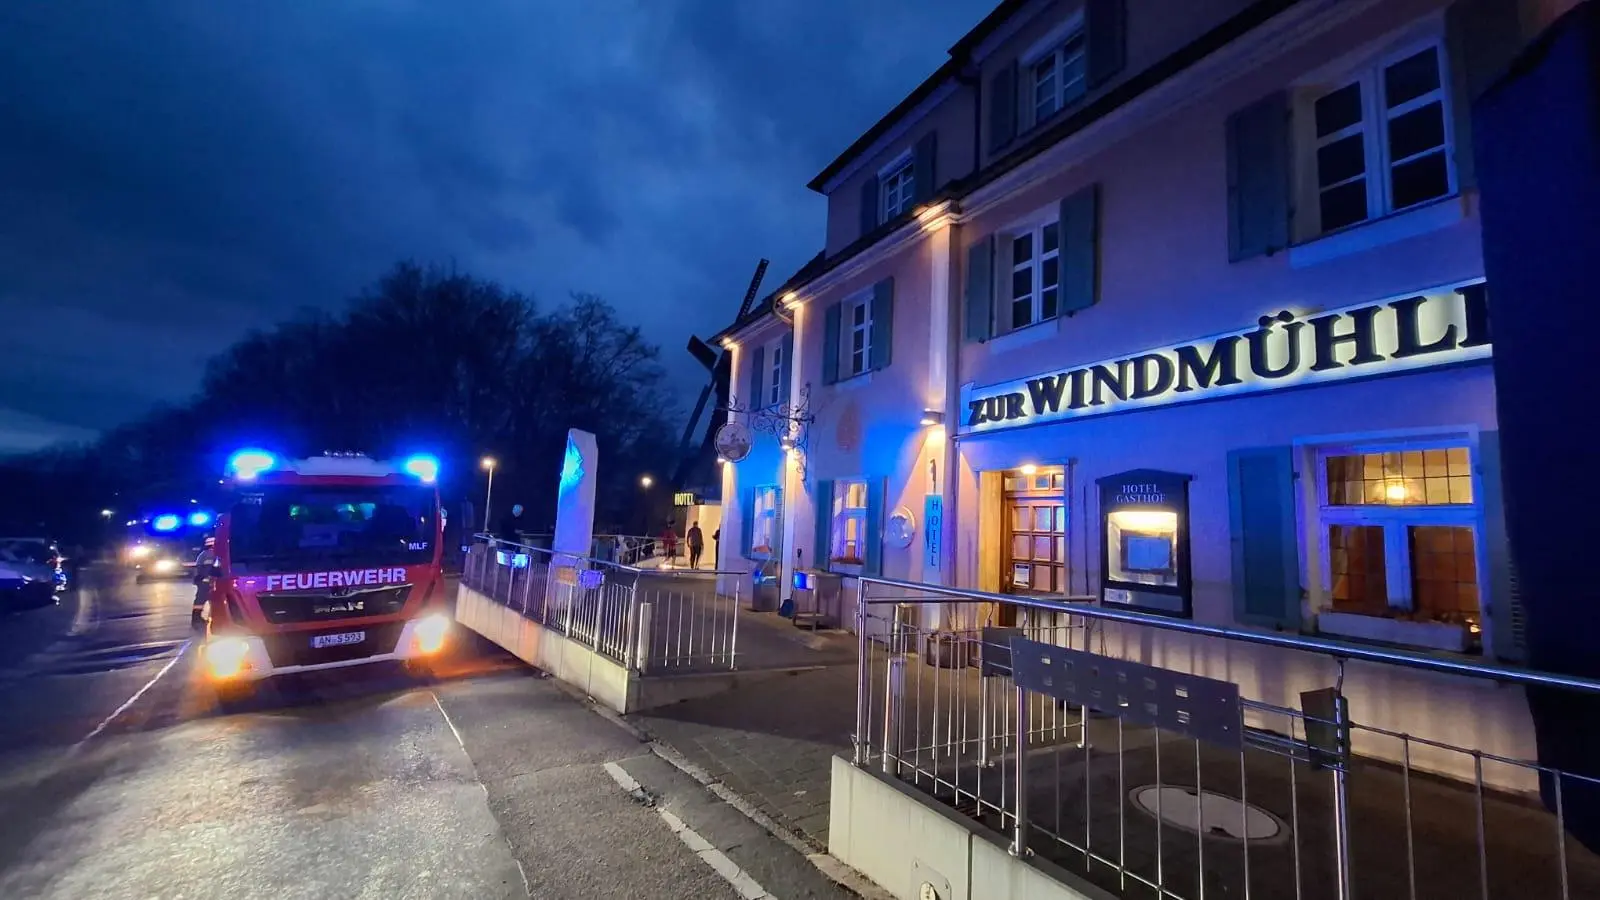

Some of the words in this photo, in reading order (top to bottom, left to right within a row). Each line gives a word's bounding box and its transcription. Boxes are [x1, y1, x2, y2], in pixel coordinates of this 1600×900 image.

[968, 392, 1027, 426] ZUR
[1122, 484, 1160, 494] HOTEL
[674, 492, 694, 506] HOTEL
[1116, 493, 1165, 504] GASTHOF
[931, 499, 939, 567] HOTEL
[408, 542, 428, 551] MLF
[266, 567, 407, 591] FEUERWEHR
[319, 636, 332, 645] AN
